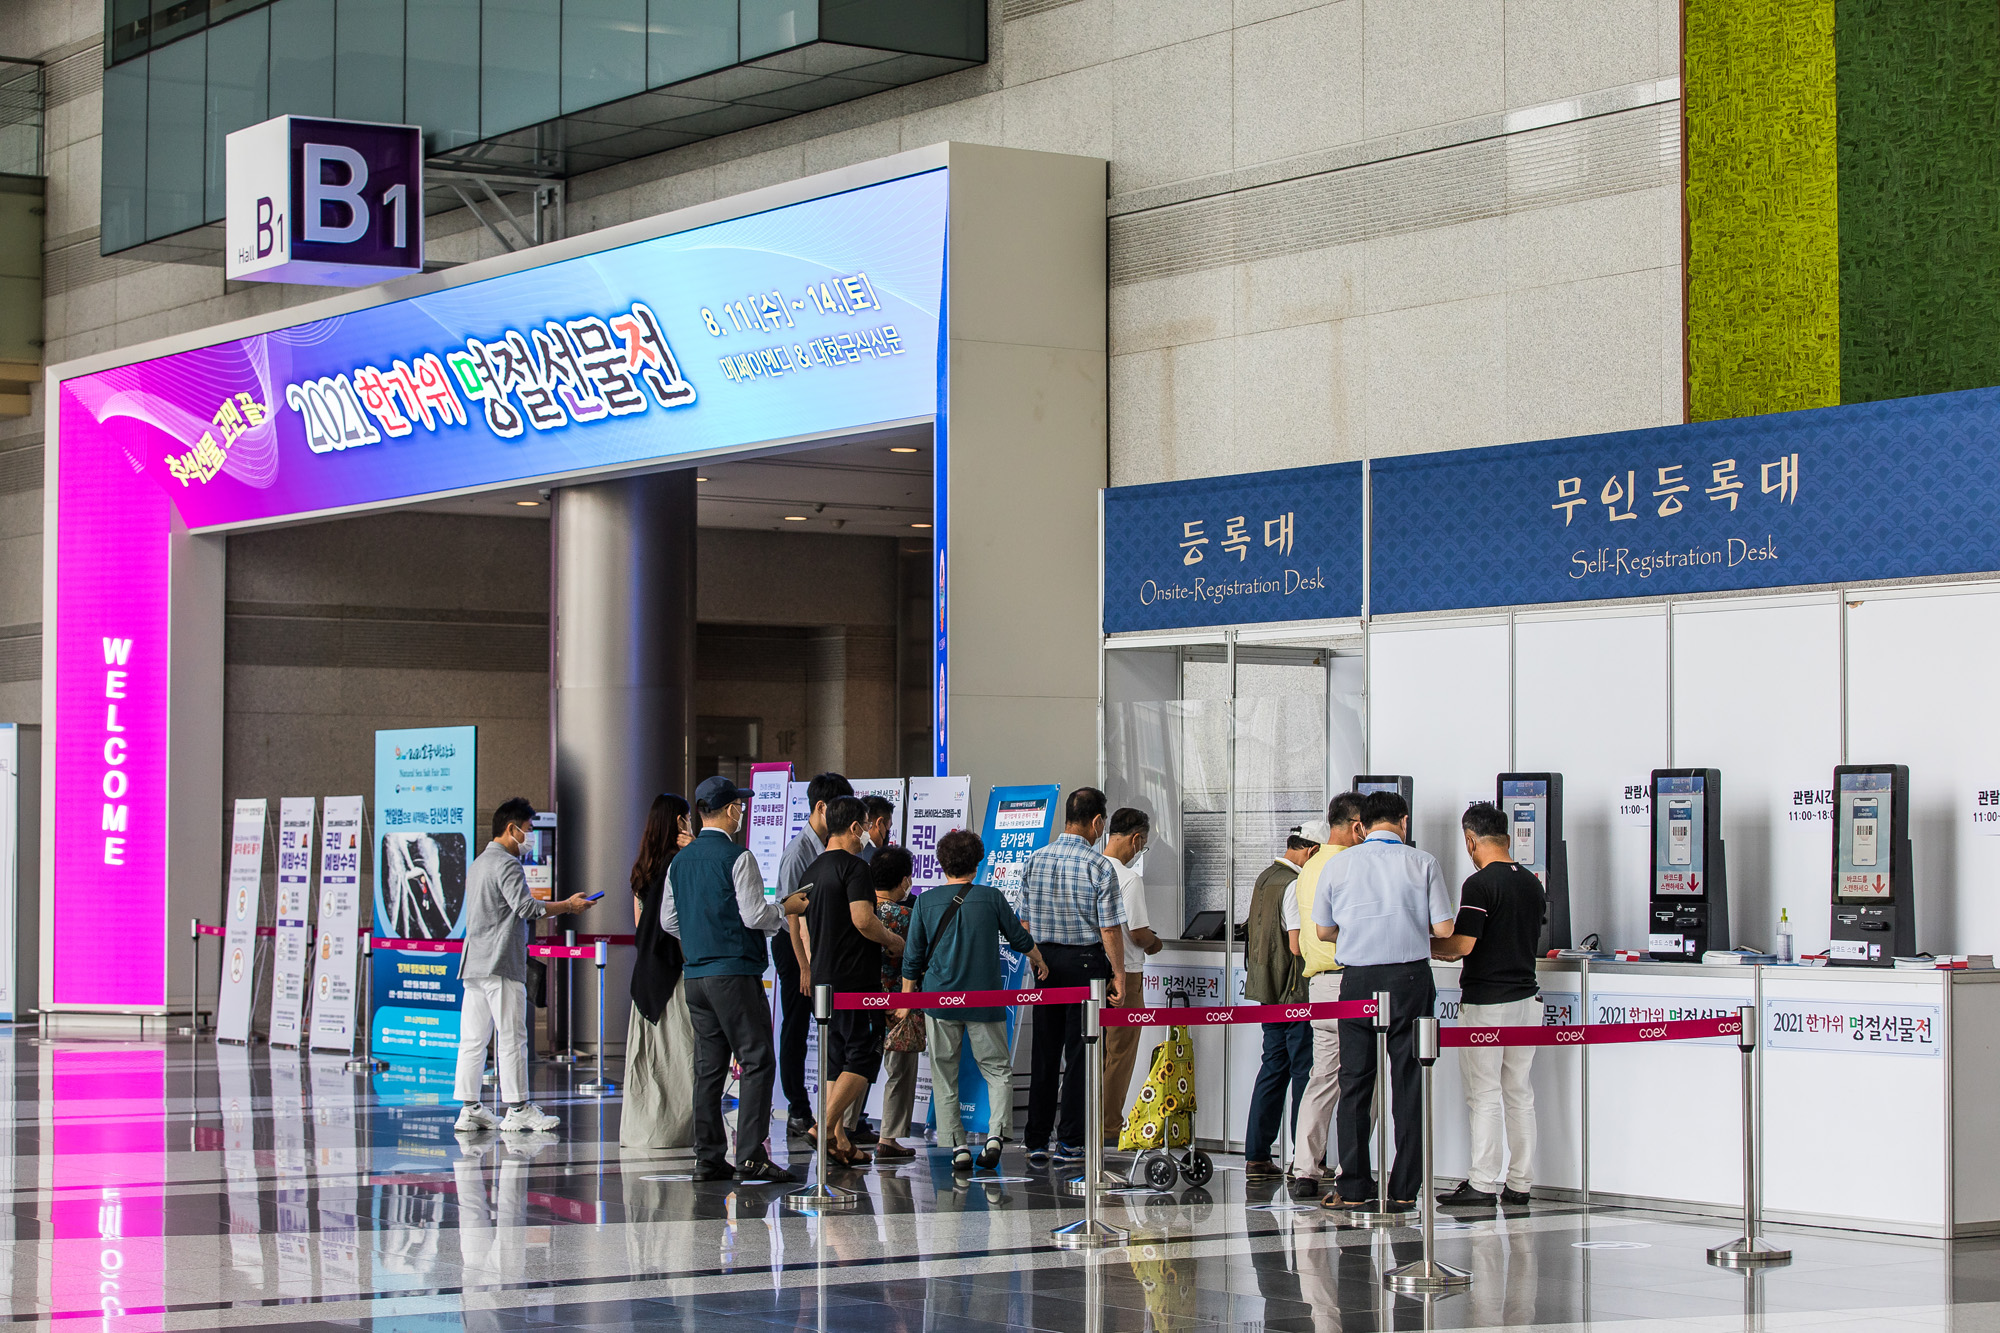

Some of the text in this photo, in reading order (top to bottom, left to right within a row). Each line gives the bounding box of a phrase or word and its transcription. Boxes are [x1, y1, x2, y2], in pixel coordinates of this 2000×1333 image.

[304, 142, 406, 248] B1
[238, 196, 284, 264] Hall B1
[793, 345, 813, 368] &
[809, 325, 906, 367] 대한급식신문
[289, 305, 694, 453] 2021 한가위 명절선물전
[212, 398, 248, 449] 고민
[1551, 453, 1798, 527] 무인등록대
[1179, 512, 1294, 566] 등록대
[1569, 534, 1778, 579] Self-Registration Desk
[1140, 566, 1325, 605] Onsite-Registration Desk
[101, 637, 132, 866] WELCOME
[1793, 789, 1834, 805] 관람시간
[1620, 804, 1650, 815] 11:00~1
[1788, 809, 1834, 821] 11:00~18:0
[282, 831, 296, 849] 국민
[325, 832, 342, 850] 국민
[912, 825, 936, 850] 국민
[1000, 832, 1035, 848] 참가업체
[281, 852, 308, 870] 예방수칙
[324, 853, 357, 871] 예방수칙
[912, 854, 944, 880] 예방수
[994, 866, 1006, 880] QR
[862, 990, 1043, 1006] coex coex coex
[1127, 1010, 1156, 1023] coex
[1206, 1009, 1233, 1022] coex
[1285, 1005, 1312, 1018] coex
[1439, 1001, 1459, 1019] 202
[1599, 1006, 1626, 1024] 2021
[1470, 1029, 1500, 1043] coex
[1556, 1028, 1585, 1042] coex
[1639, 1024, 1668, 1038] coex
[1773, 1012, 1932, 1043] 2021 한가위 명절선물전
